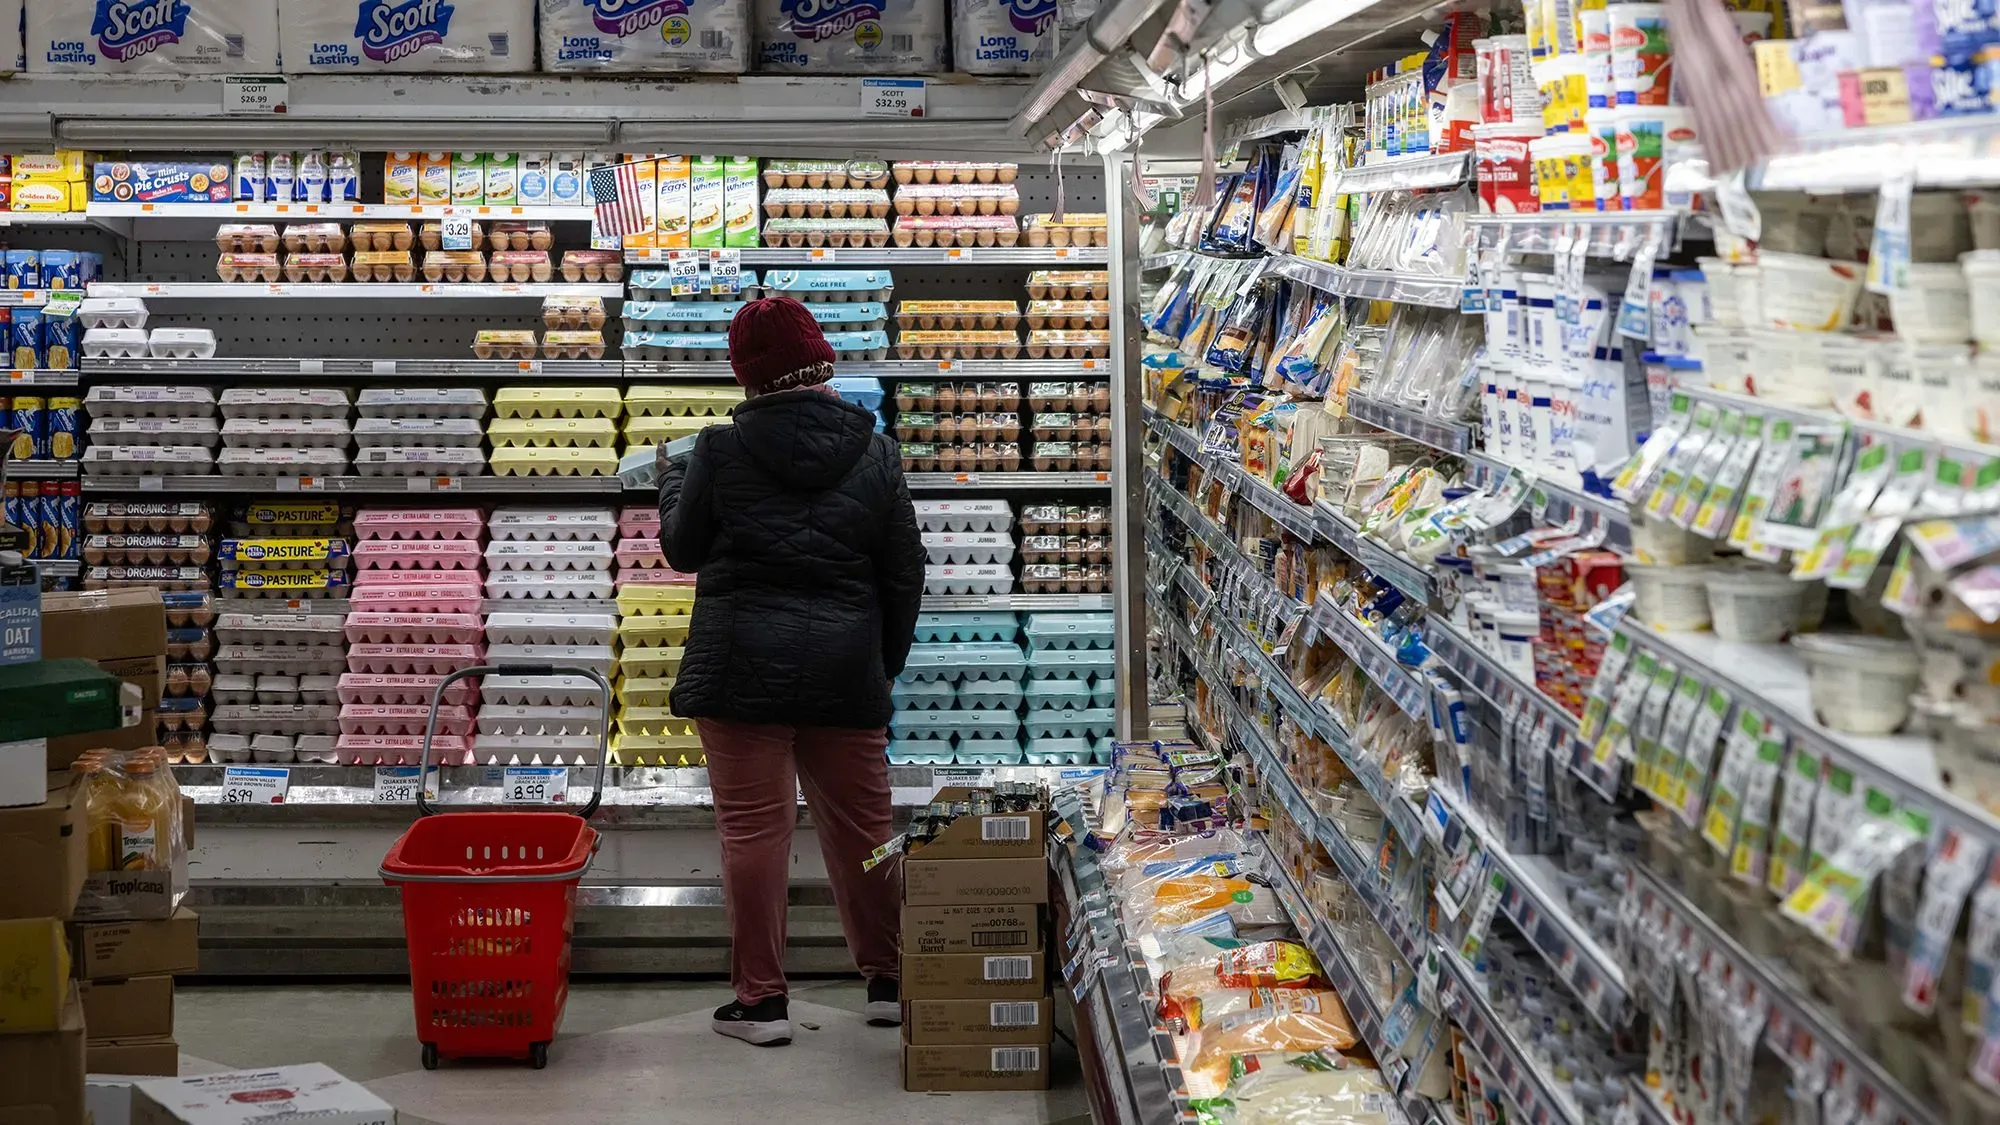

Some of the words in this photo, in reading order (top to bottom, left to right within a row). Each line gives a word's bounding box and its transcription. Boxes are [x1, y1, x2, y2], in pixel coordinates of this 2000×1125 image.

[103, 0, 175, 41] Scott
[368, 0, 440, 43] Scott
[619, 10, 662, 38] 1000
[813, 13, 856, 42] 1000
[51, 40, 85, 54] Long
[563, 36, 601, 50] Long
[761, 41, 797, 54] Long
[980, 35, 1017, 51] Long
[120, 37, 157, 62] 1000
[313, 43, 348, 57] Long
[384, 38, 421, 63] 1000
[558, 47, 613, 62] Lasting
[976, 48, 1029, 62] Lasting
[47, 51, 96, 66] Lasting
[309, 53, 360, 67] Lasting
[757, 52, 808, 66] Lasting
[240, 95, 268, 103] $26.99
[875, 98, 907, 108] $32.99
[46, 163, 61, 171] Ray
[391, 167, 412, 178] Eggs
[425, 166, 445, 177] Eggs
[457, 170, 477, 179] Whites
[490, 170, 511, 179] Whites
[660, 181, 687, 194] Eggs
[692, 181, 721, 192] Whites
[726, 180, 754, 192] Whites
[19, 192, 46, 200] Golden
[46, 193, 61, 201] Ray
[445, 223, 469, 236] $3.29
[672, 265, 697, 276] $5.69
[713, 266, 737, 276] $5.69
[127, 504, 167, 514] ORGANIC
[277, 510, 325, 521] PASTURE
[126, 536, 166, 546] ORGANIC
[267, 546, 315, 557] PASTURE
[127, 567, 167, 578] ORGANIC
[266, 575, 315, 586] PASTURE
[0, 607, 39, 619] CALIFIA
[5, 627, 31, 645] OAT
[3, 648, 35, 656] BARISTA
[123, 836, 155, 846] Tropicana
[107, 879, 164, 896] Tropicana
[990, 918, 1018, 927] 00768
[918, 937, 946, 945] Cracker
[920, 945, 944, 953] Barrel
